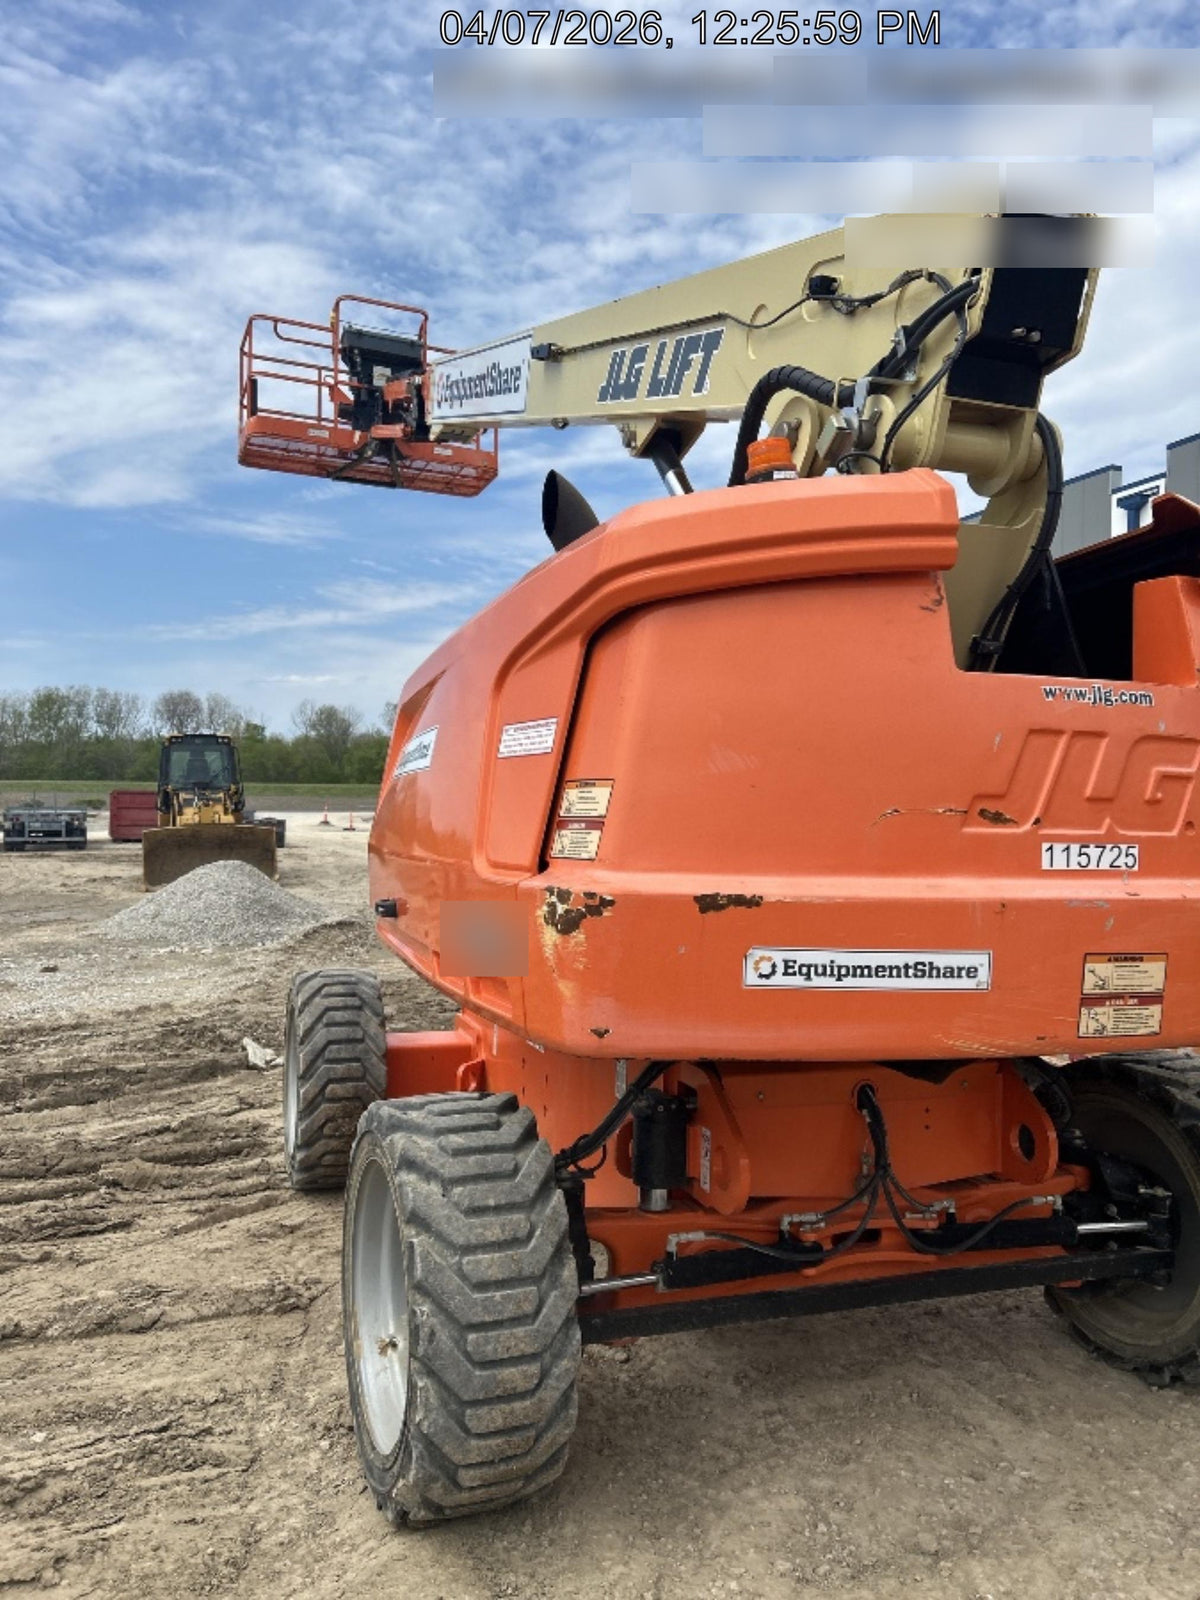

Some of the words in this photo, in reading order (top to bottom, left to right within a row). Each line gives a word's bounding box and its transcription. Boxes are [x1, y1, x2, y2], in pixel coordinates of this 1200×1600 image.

[596, 342, 650, 403] JLG
[645, 327, 726, 399] LIFT
[961, 728, 1200, 836] JLG
[1045, 844, 1137, 869] 115725
[782, 959, 979, 982] EquipmentShare
